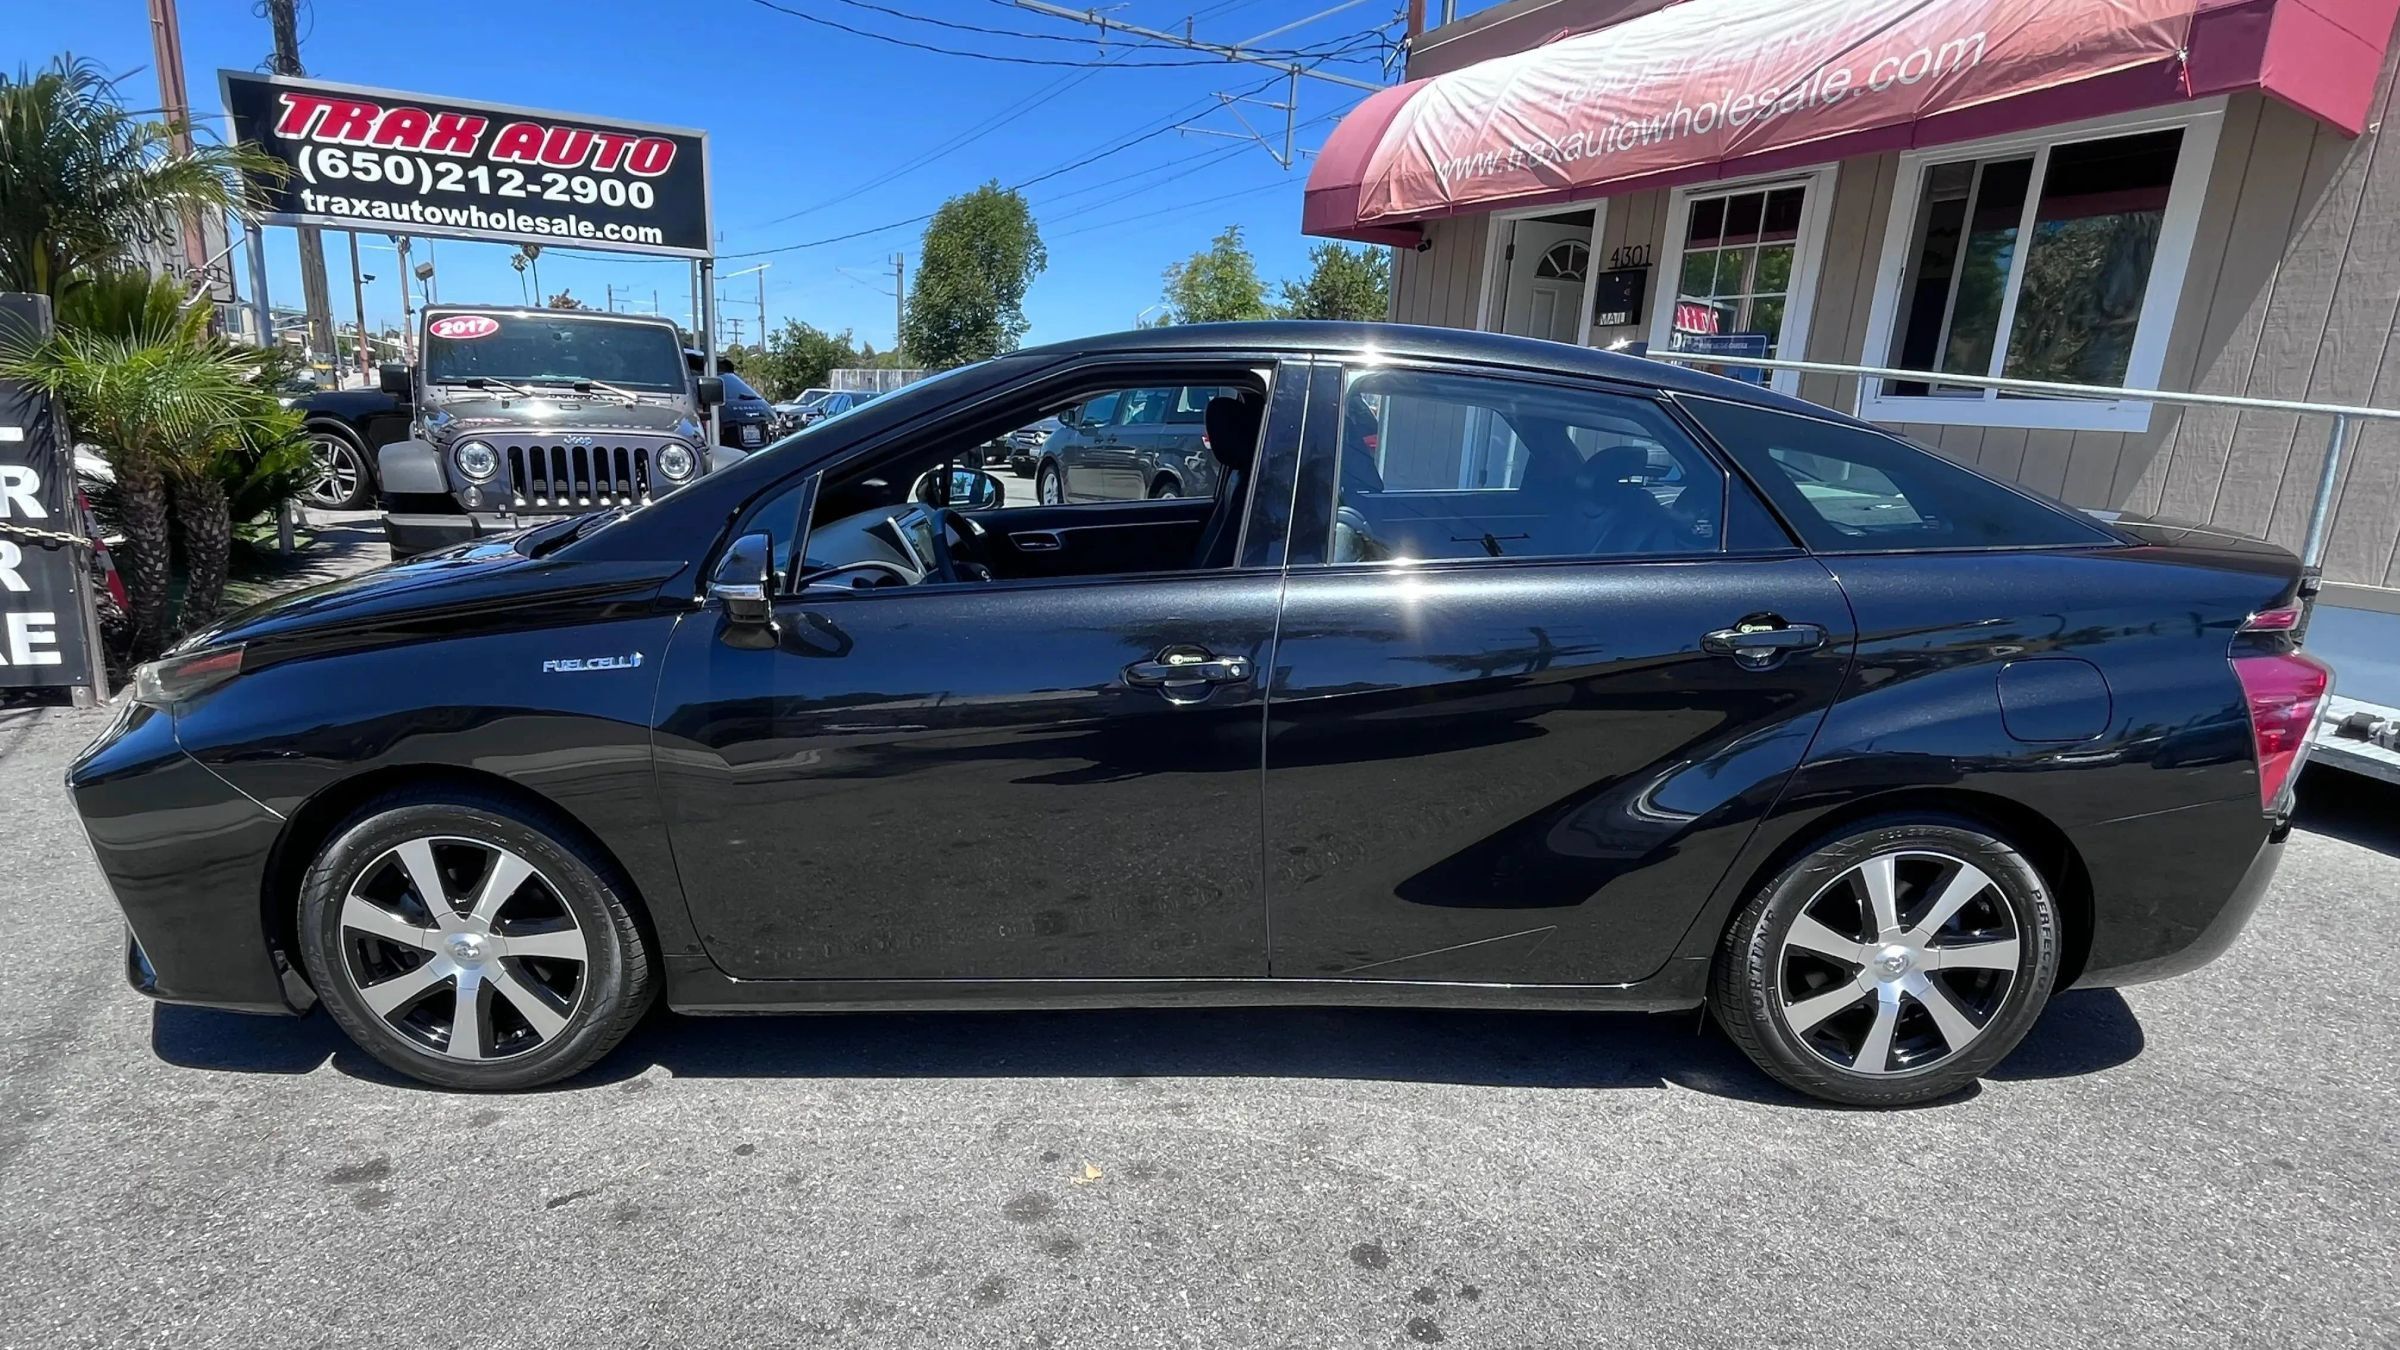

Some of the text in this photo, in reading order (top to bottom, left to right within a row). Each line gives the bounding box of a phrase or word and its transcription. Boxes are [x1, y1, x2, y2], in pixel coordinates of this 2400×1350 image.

[274, 91, 678, 178] TRAX AUTO
[297, 144, 655, 210] (650)212-2900
[300, 188, 664, 245] traxautowholesale.com
[1609, 244, 1652, 268] 4301
[439, 319, 489, 336] 2017
